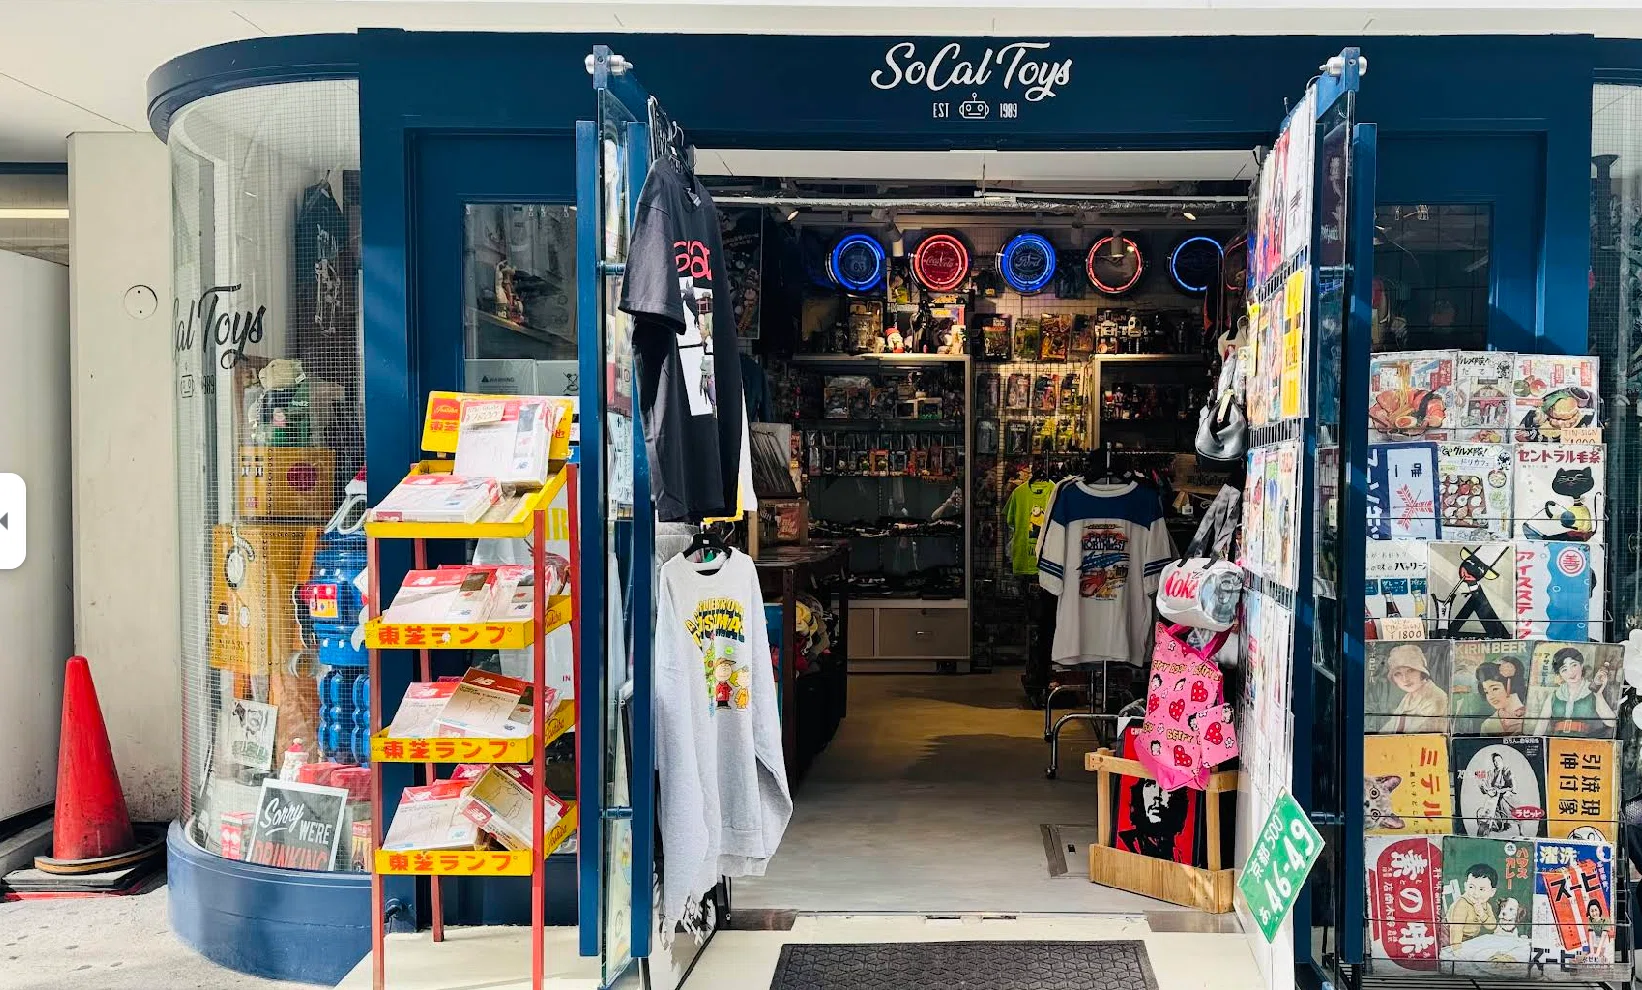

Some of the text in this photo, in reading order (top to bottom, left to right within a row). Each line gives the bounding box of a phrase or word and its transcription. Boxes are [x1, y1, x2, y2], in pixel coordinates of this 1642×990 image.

[870, 42, 1073, 102] SoCal Toys
[932, 102, 1018, 118] EST 1989
[1015, 254, 1041, 267] Ford
[198, 283, 267, 369] Toys
[1517, 449, 1601, 464] セントラル毛糸
[378, 625, 512, 645] 東芝ランプ
[1455, 641, 1527, 655] KIRIN BEER
[383, 740, 515, 760] 東芝ランプ
[260, 798, 305, 833] Sorry
[1515, 808, 1542, 818] ラビット
[389, 853, 518, 872] 東芝ランプ
[1516, 847, 1529, 879] ハウス
[1505, 857, 1516, 890] カレー
